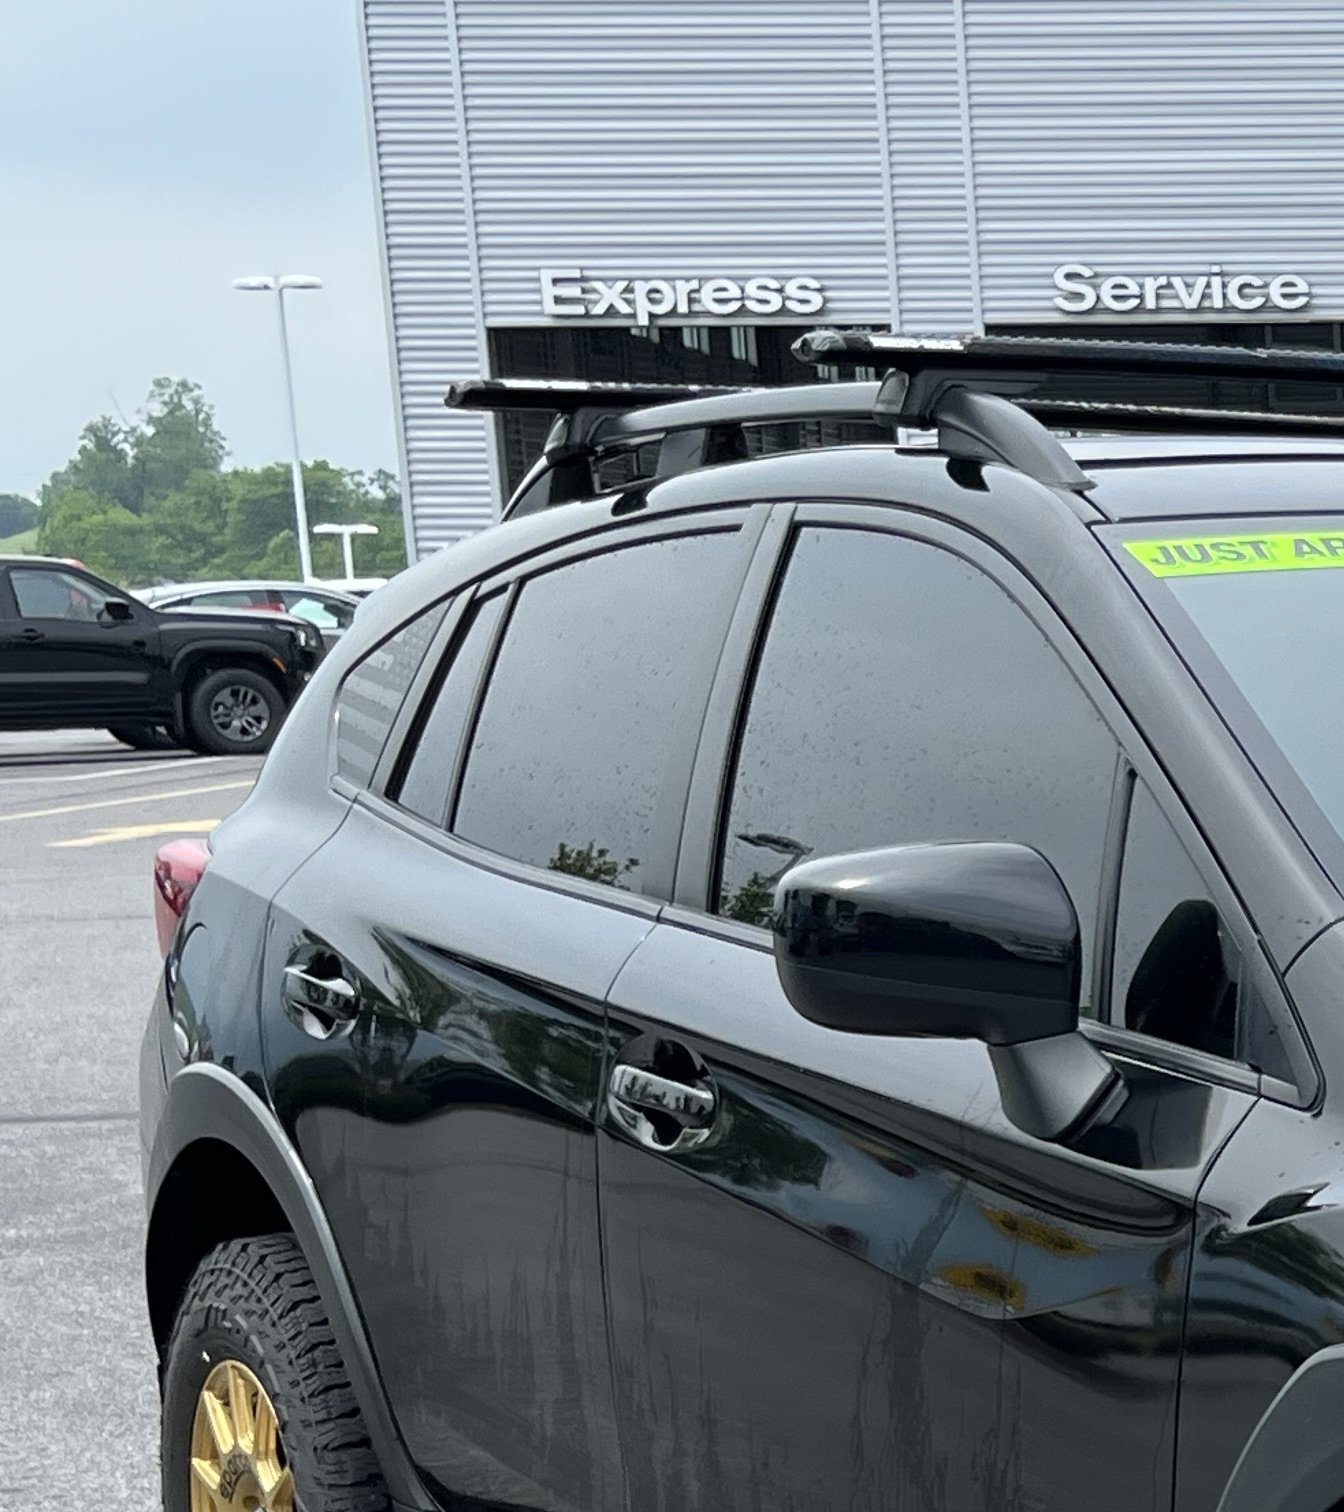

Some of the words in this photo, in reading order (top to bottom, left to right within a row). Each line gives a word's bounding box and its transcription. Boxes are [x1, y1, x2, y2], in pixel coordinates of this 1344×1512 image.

[539, 267, 826, 324] Express
[1052, 264, 1312, 313] Service
[1151, 539, 1275, 567] JUST
